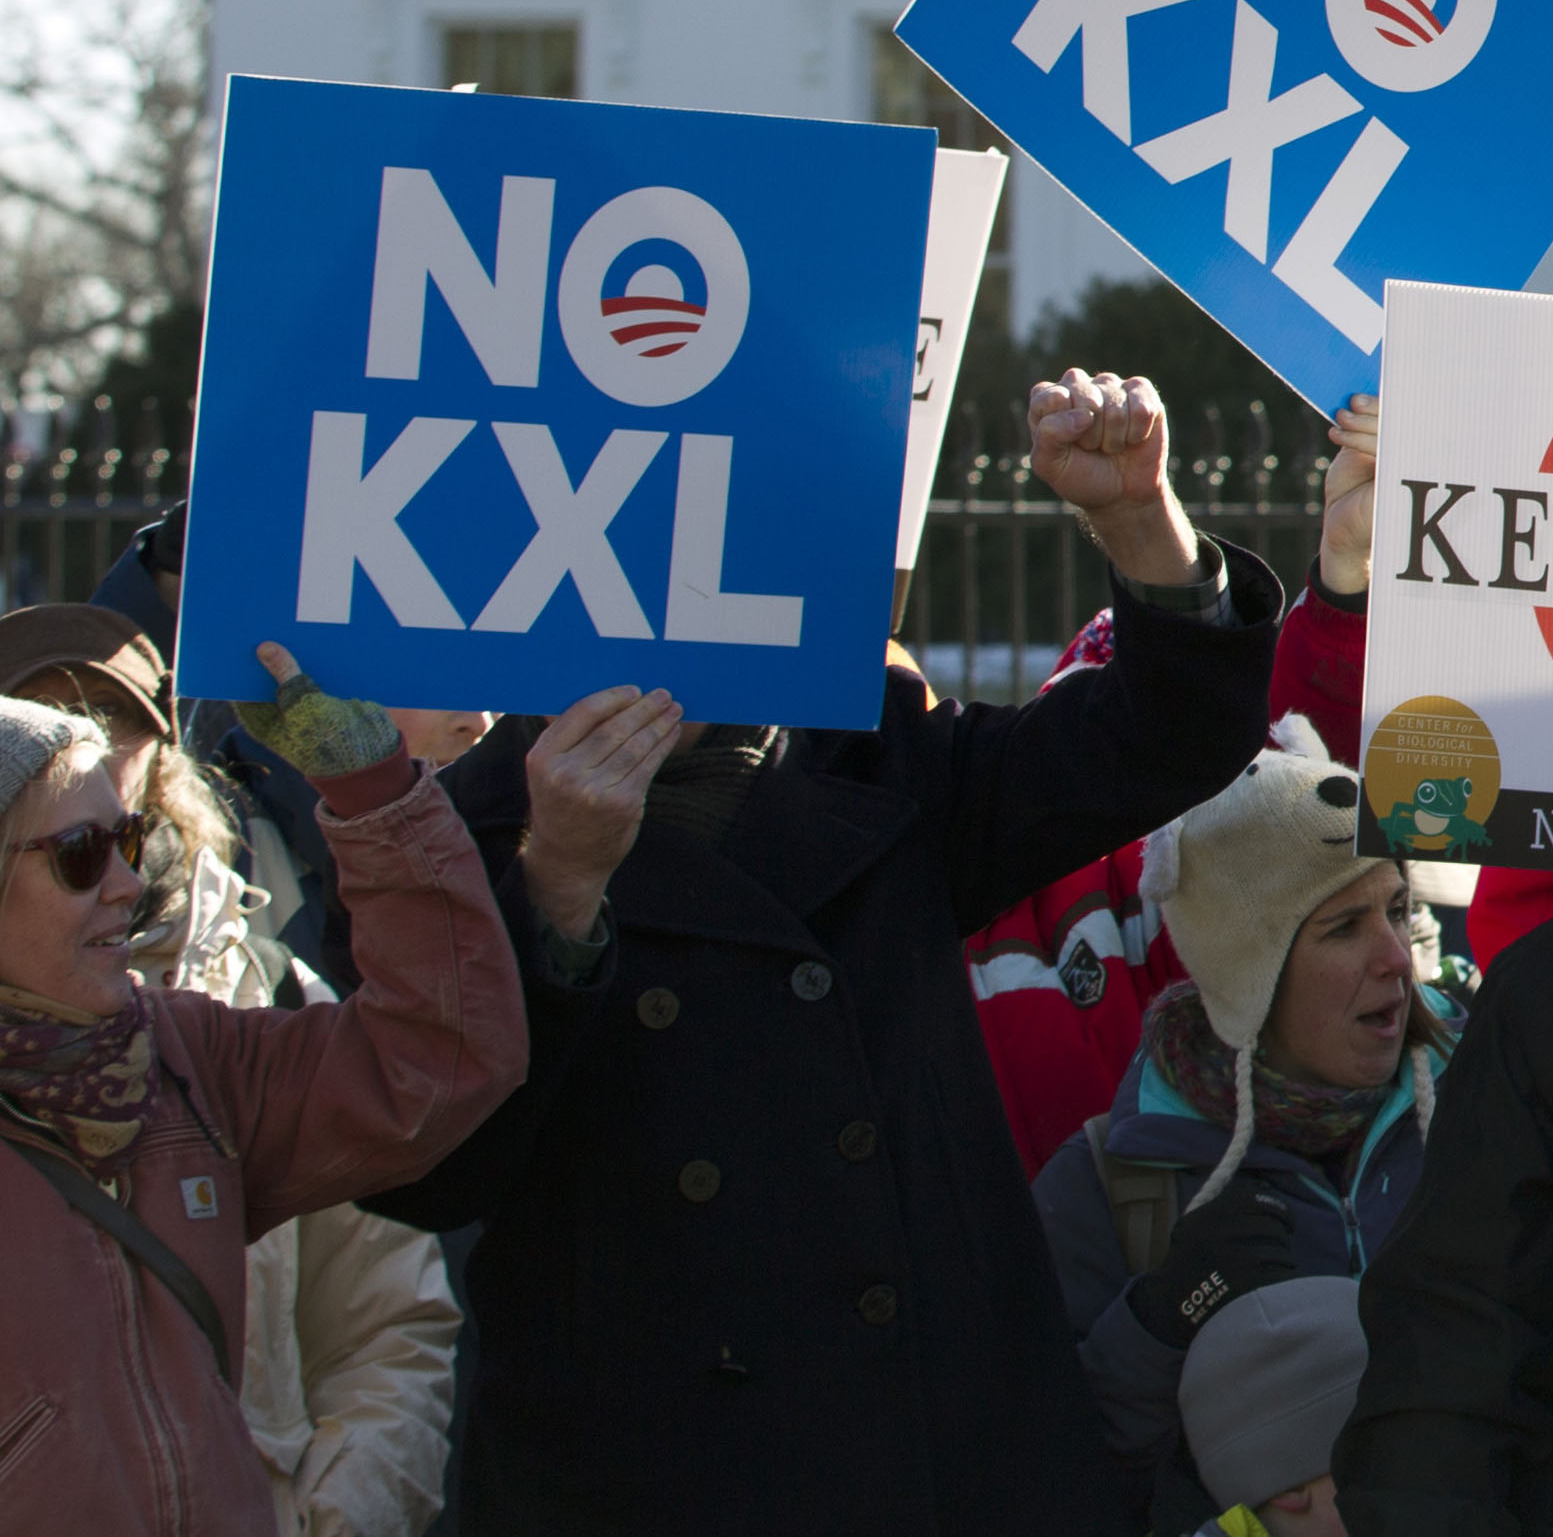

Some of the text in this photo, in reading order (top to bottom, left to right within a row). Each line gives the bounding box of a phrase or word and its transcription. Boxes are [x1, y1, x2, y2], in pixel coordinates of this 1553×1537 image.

[364, 166, 750, 407] NO
[295, 410, 805, 647] KXL
[1397, 716, 1473, 735] CENTER for
[1397, 734, 1473, 751] BIOLOGICAL
[1395, 752, 1473, 769] DIVERSITY
[1180, 1270, 1224, 1316] GORE
